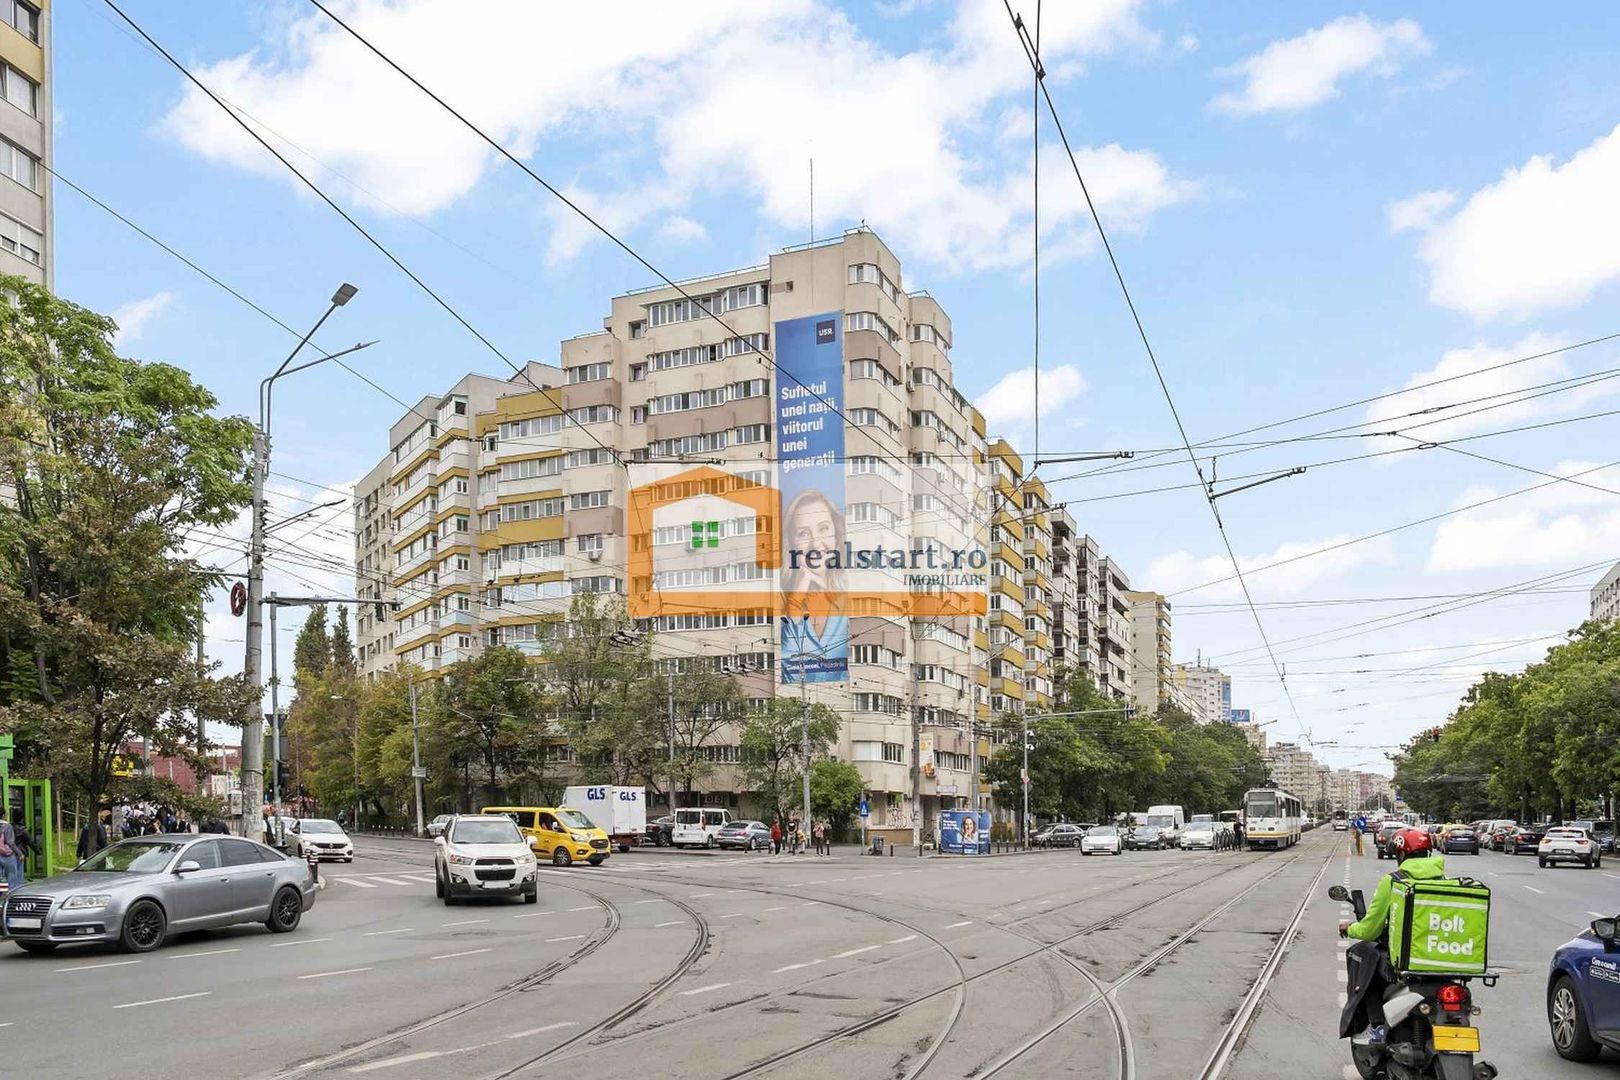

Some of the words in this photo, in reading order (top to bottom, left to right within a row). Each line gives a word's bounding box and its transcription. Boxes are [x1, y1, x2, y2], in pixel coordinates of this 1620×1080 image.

[818, 327, 833, 336] USR
[781, 381, 827, 400] Sufletul
[781, 401, 807, 417] unei
[782, 417, 824, 435] viitorul
[782, 437, 807, 453] unei
[782, 450, 835, 473] generații
[587, 788, 605, 801] GLS
[620, 791, 636, 801] GLS
[1429, 912, 1465, 937] Bolt
[1427, 935, 1474, 956] Food
